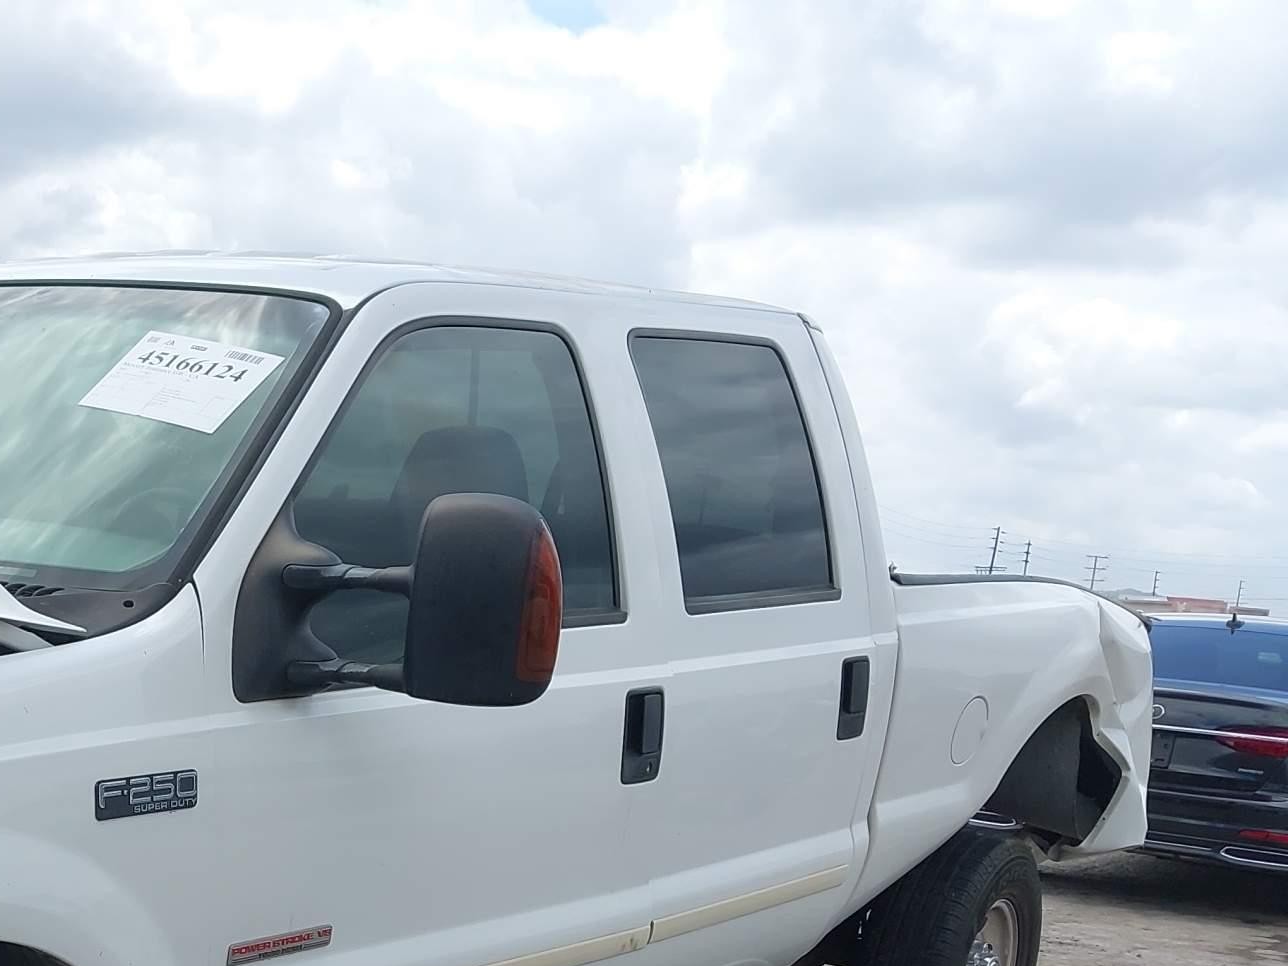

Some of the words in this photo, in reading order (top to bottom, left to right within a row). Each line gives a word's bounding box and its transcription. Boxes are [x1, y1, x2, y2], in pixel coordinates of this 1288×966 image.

[137, 350, 248, 382] 45166124
[133, 801, 168, 813] SUPER
[170, 797, 197, 808] DUTY
[231, 941, 272, 956] POWER
[271, 932, 314, 948] STROKE
